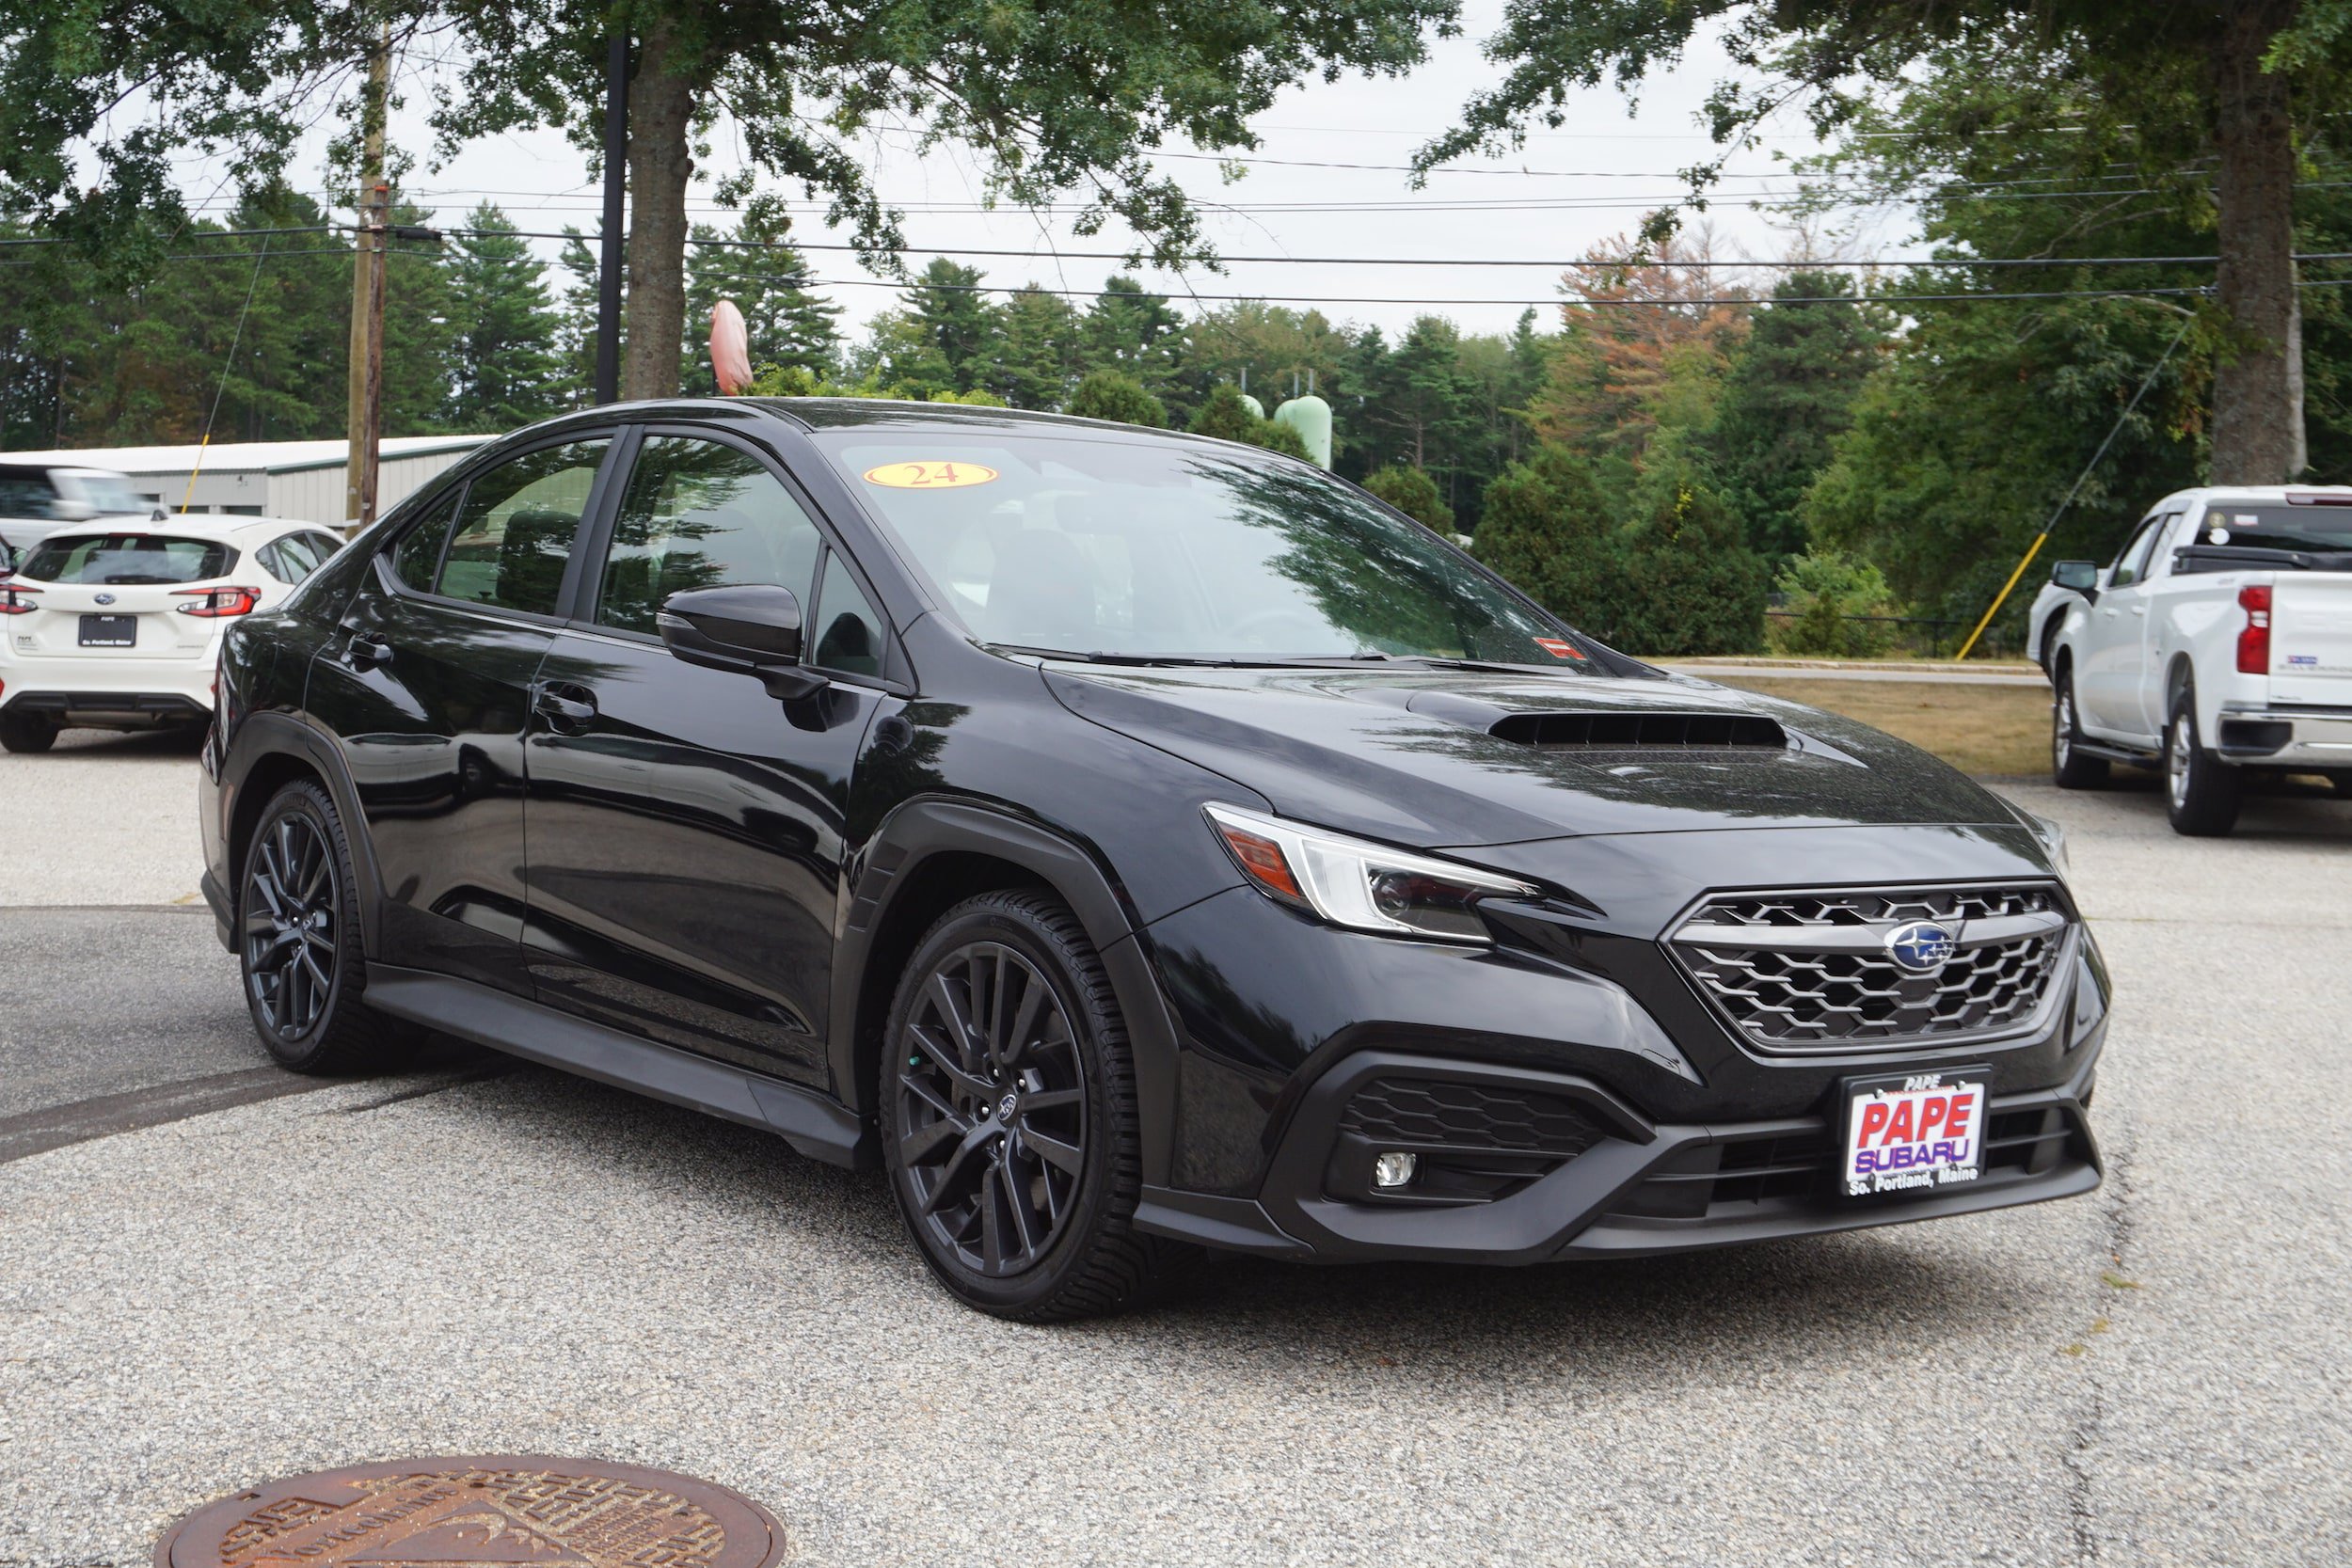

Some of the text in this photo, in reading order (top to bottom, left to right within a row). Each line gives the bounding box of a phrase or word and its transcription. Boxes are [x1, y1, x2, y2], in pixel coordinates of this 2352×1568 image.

[904, 463, 959, 485] 24
[1903, 1074, 1942, 1091] PAPE
[1857, 1094, 1975, 1148] PAPE
[1855, 1139, 1970, 1174] SUBARU
[1849, 1180, 1870, 1196] So.
[1875, 1172, 1933, 1192] Portland,
[1938, 1166, 1979, 1184] Maine
